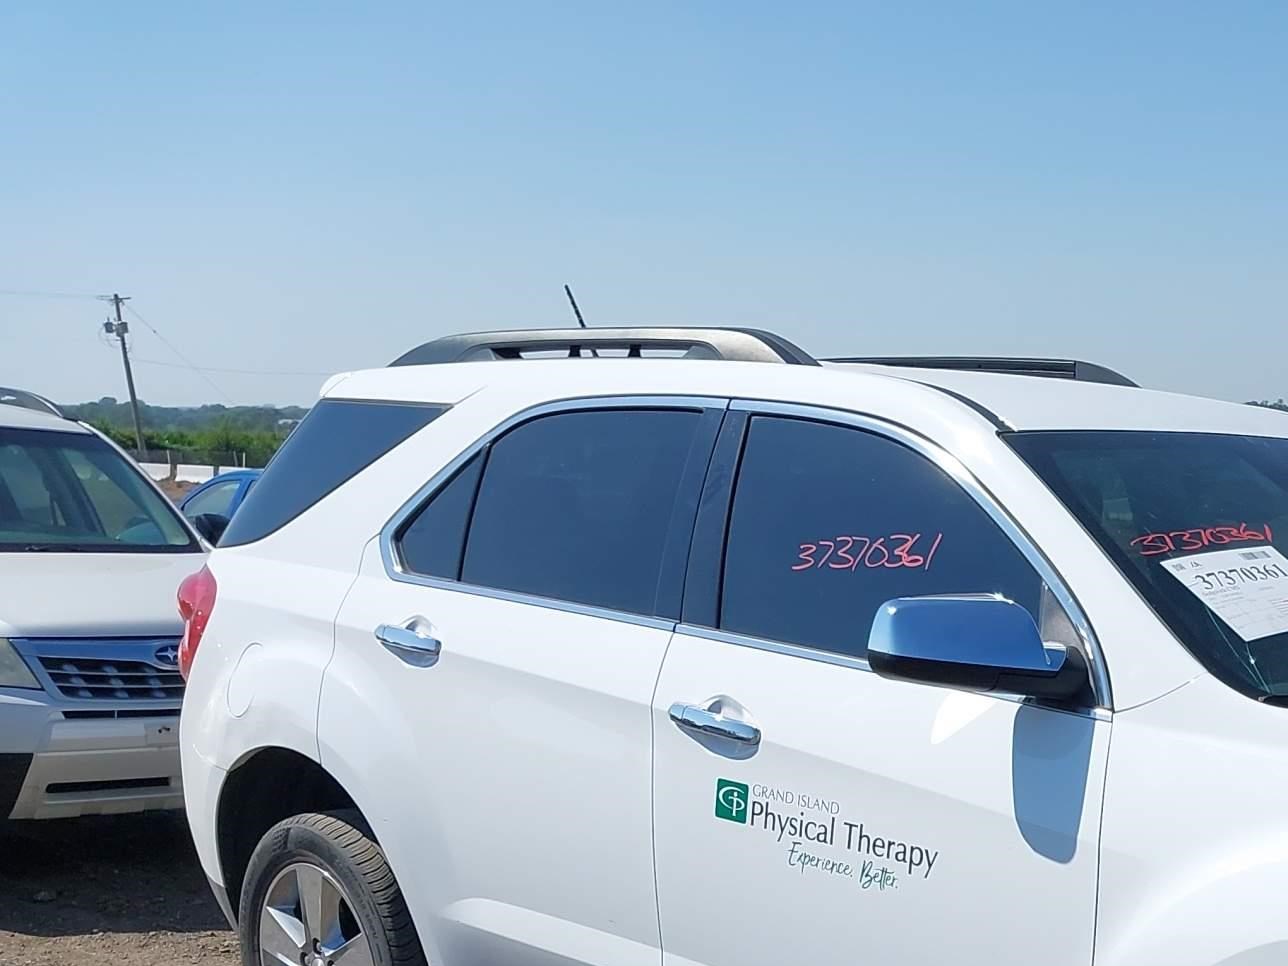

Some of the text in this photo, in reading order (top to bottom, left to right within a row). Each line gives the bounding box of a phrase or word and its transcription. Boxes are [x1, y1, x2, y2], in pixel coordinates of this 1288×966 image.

[791, 532, 943, 573] 37370361
[1130, 522, 1273, 556] 37370361
[1194, 563, 1288, 590] 37370361
[752, 783, 840, 815] GRAND ISLAND
[750, 800, 939, 879] Physical Therapy
[787, 841, 899, 891] Experience. Better.
